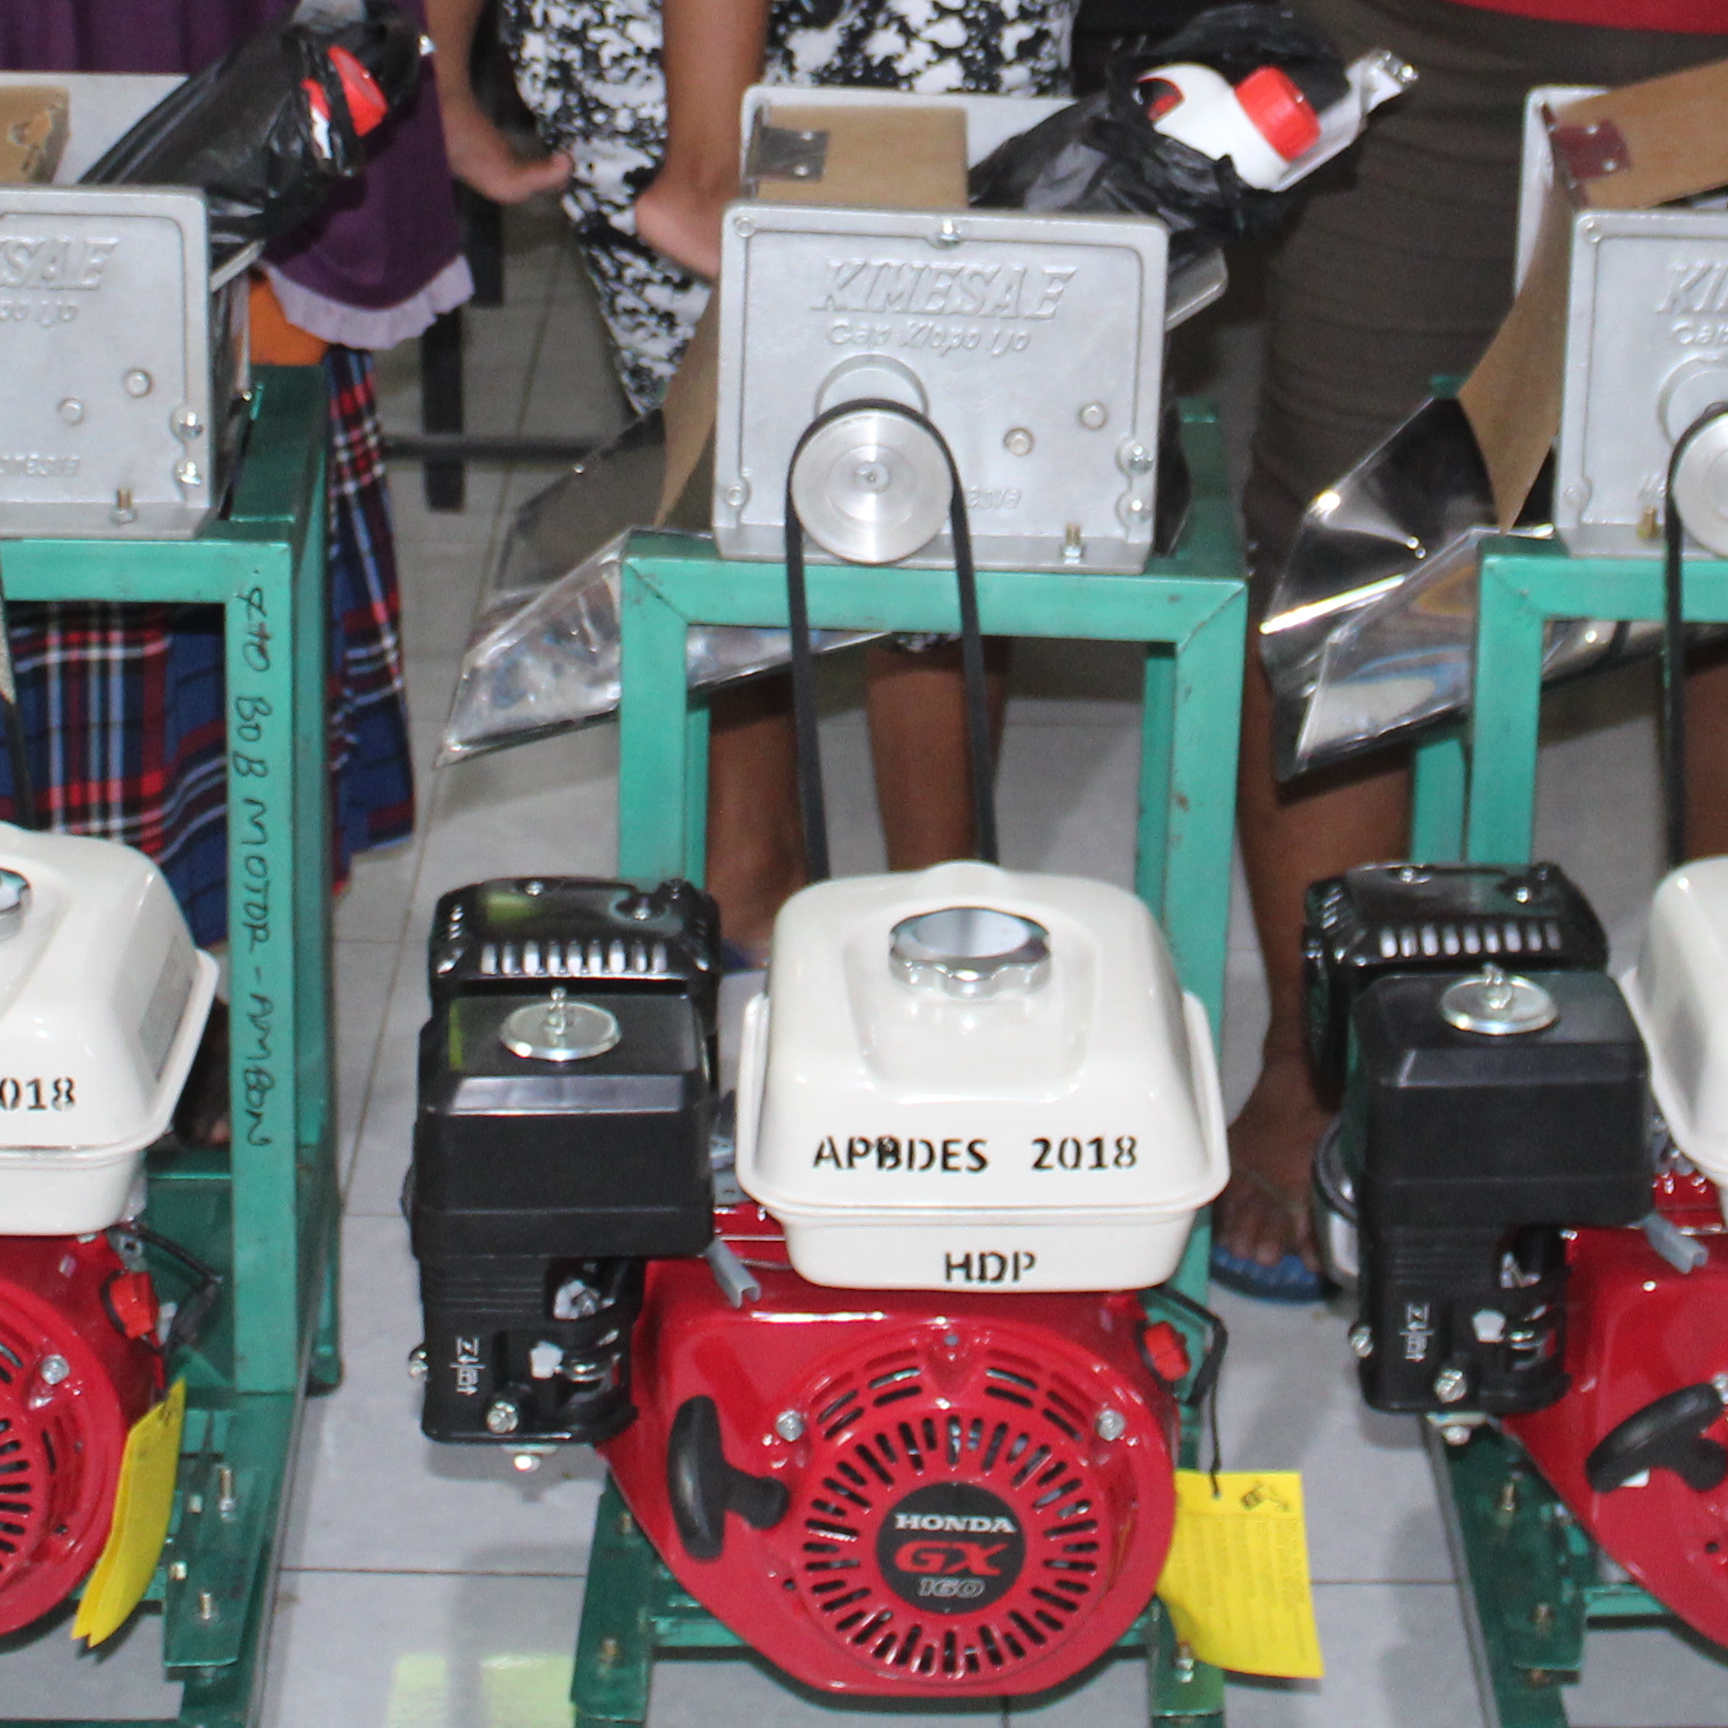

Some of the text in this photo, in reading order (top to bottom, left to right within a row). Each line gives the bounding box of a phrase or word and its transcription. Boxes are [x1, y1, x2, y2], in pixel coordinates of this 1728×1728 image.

[811, 259, 1079, 321] KIMESAE
[239, 797, 272, 954] MOTOR
[241, 992, 276, 1148] AMBON
[813, 1136, 1138, 1173] APBDES 2018
[944, 1251, 1035, 1285] HDP
[895, 1512, 1018, 1535] HONDA
[895, 1540, 1006, 1576] GX
[917, 1575, 986, 1599] 160
